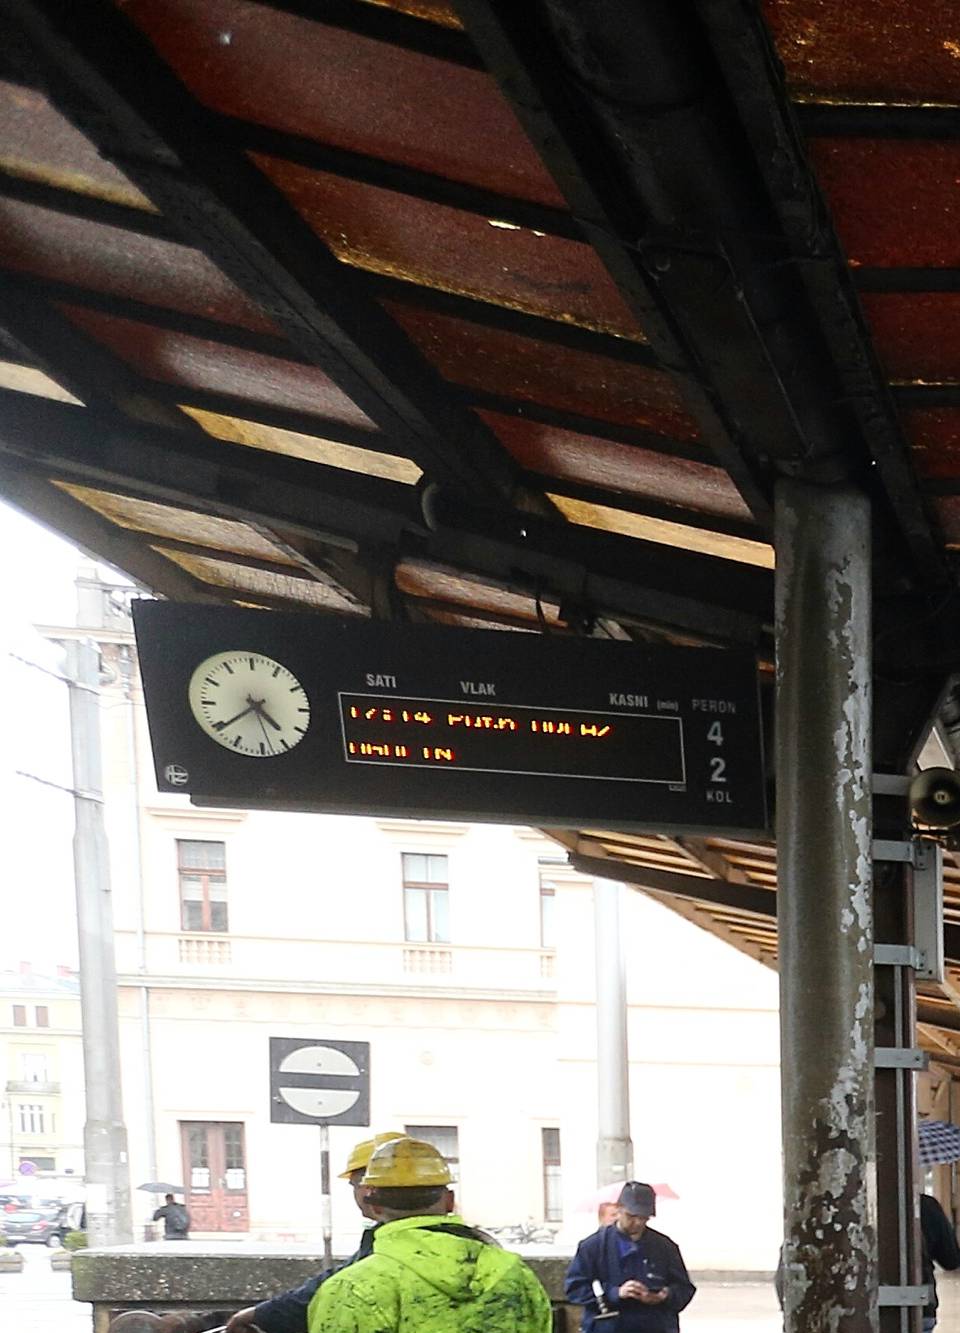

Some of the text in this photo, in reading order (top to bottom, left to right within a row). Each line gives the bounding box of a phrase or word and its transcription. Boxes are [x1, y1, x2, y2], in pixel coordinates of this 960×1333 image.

[366, 673, 398, 689] SATI
[460, 681, 497, 697] VLAK
[608, 693, 649, 709] KASNI
[691, 699, 737, 714] PERON
[706, 720, 725, 747] 4
[709, 757, 727, 783] 2
[705, 789, 733, 804] KOL
